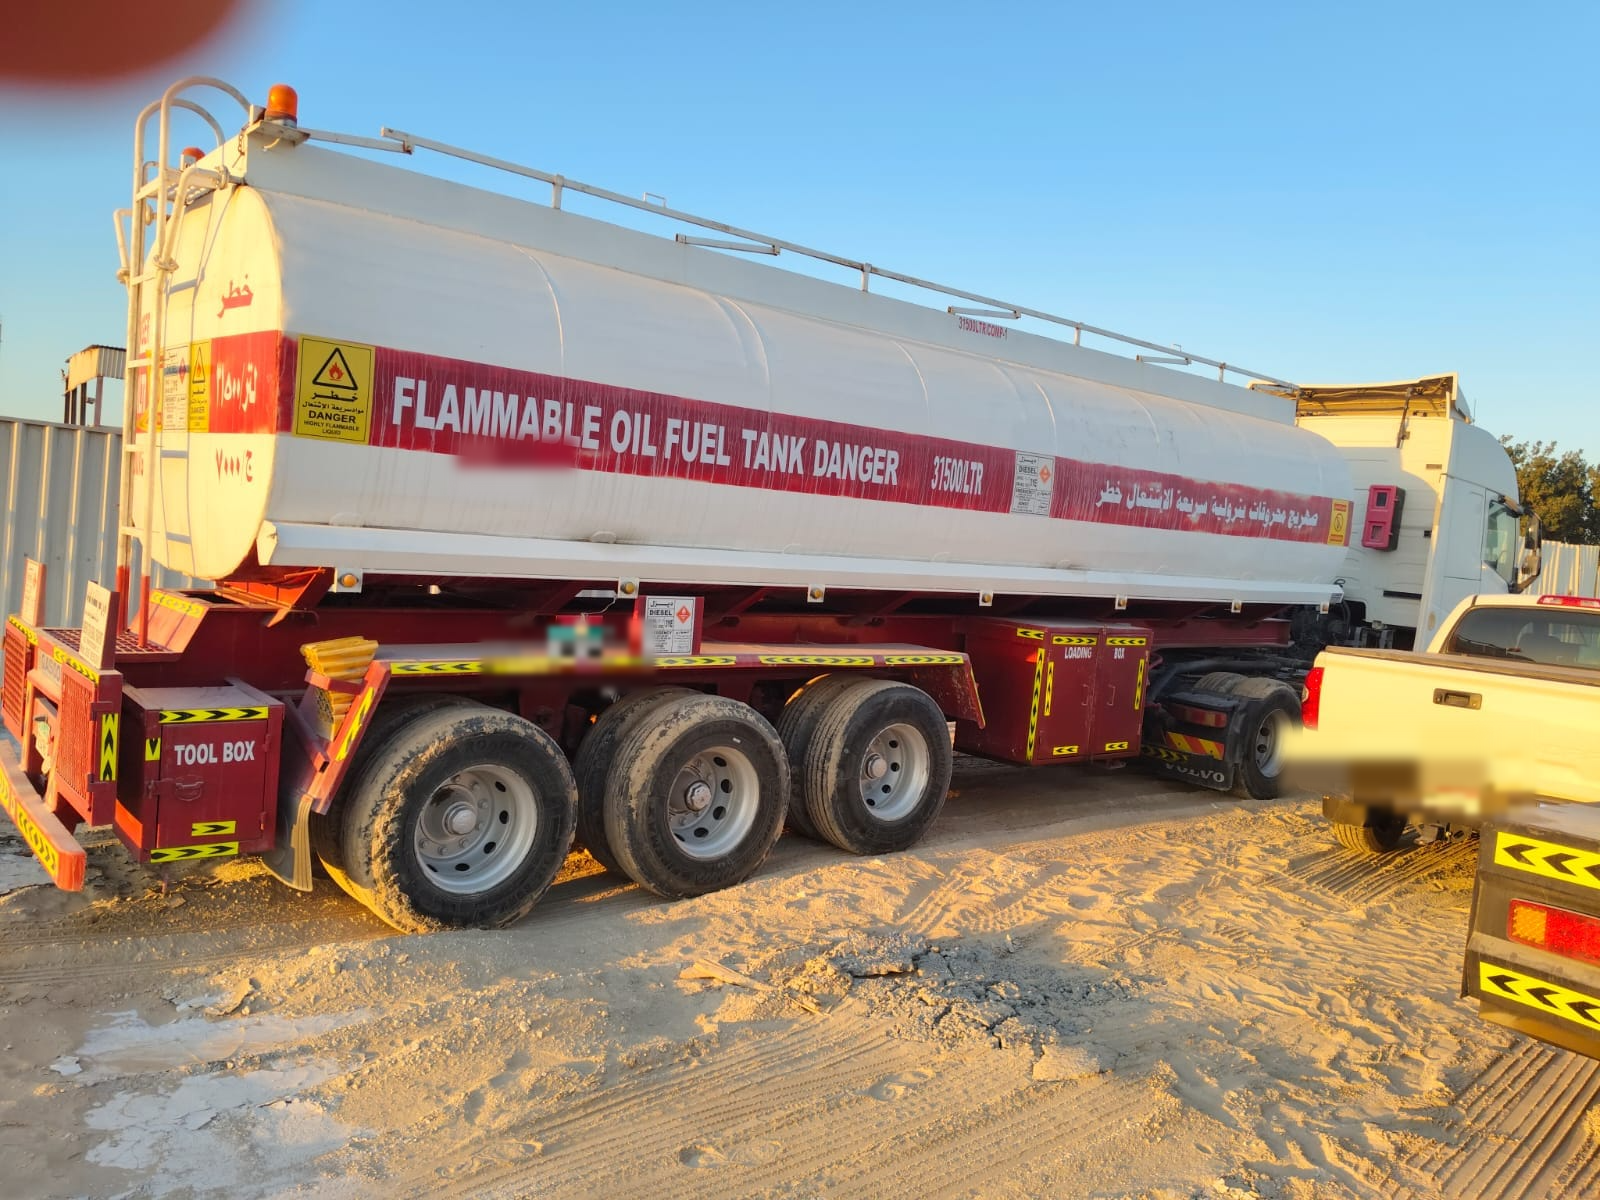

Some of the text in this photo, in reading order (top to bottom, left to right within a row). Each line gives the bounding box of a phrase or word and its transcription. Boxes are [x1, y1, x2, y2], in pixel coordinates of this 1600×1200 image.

[216, 273, 253, 318] خطر
[312, 390, 358, 402] خطر
[304, 420, 359, 431] HIGHLY FLAMMABLE
[308, 410, 356, 423] DANGER
[392, 376, 900, 485] FLAMMABLE OIL FUEL TANK DANGER
[1095, 480, 1123, 508] خطر
[1064, 647, 1125, 659] LOADING BOX
[174, 740, 256, 766] TOOL BOX
